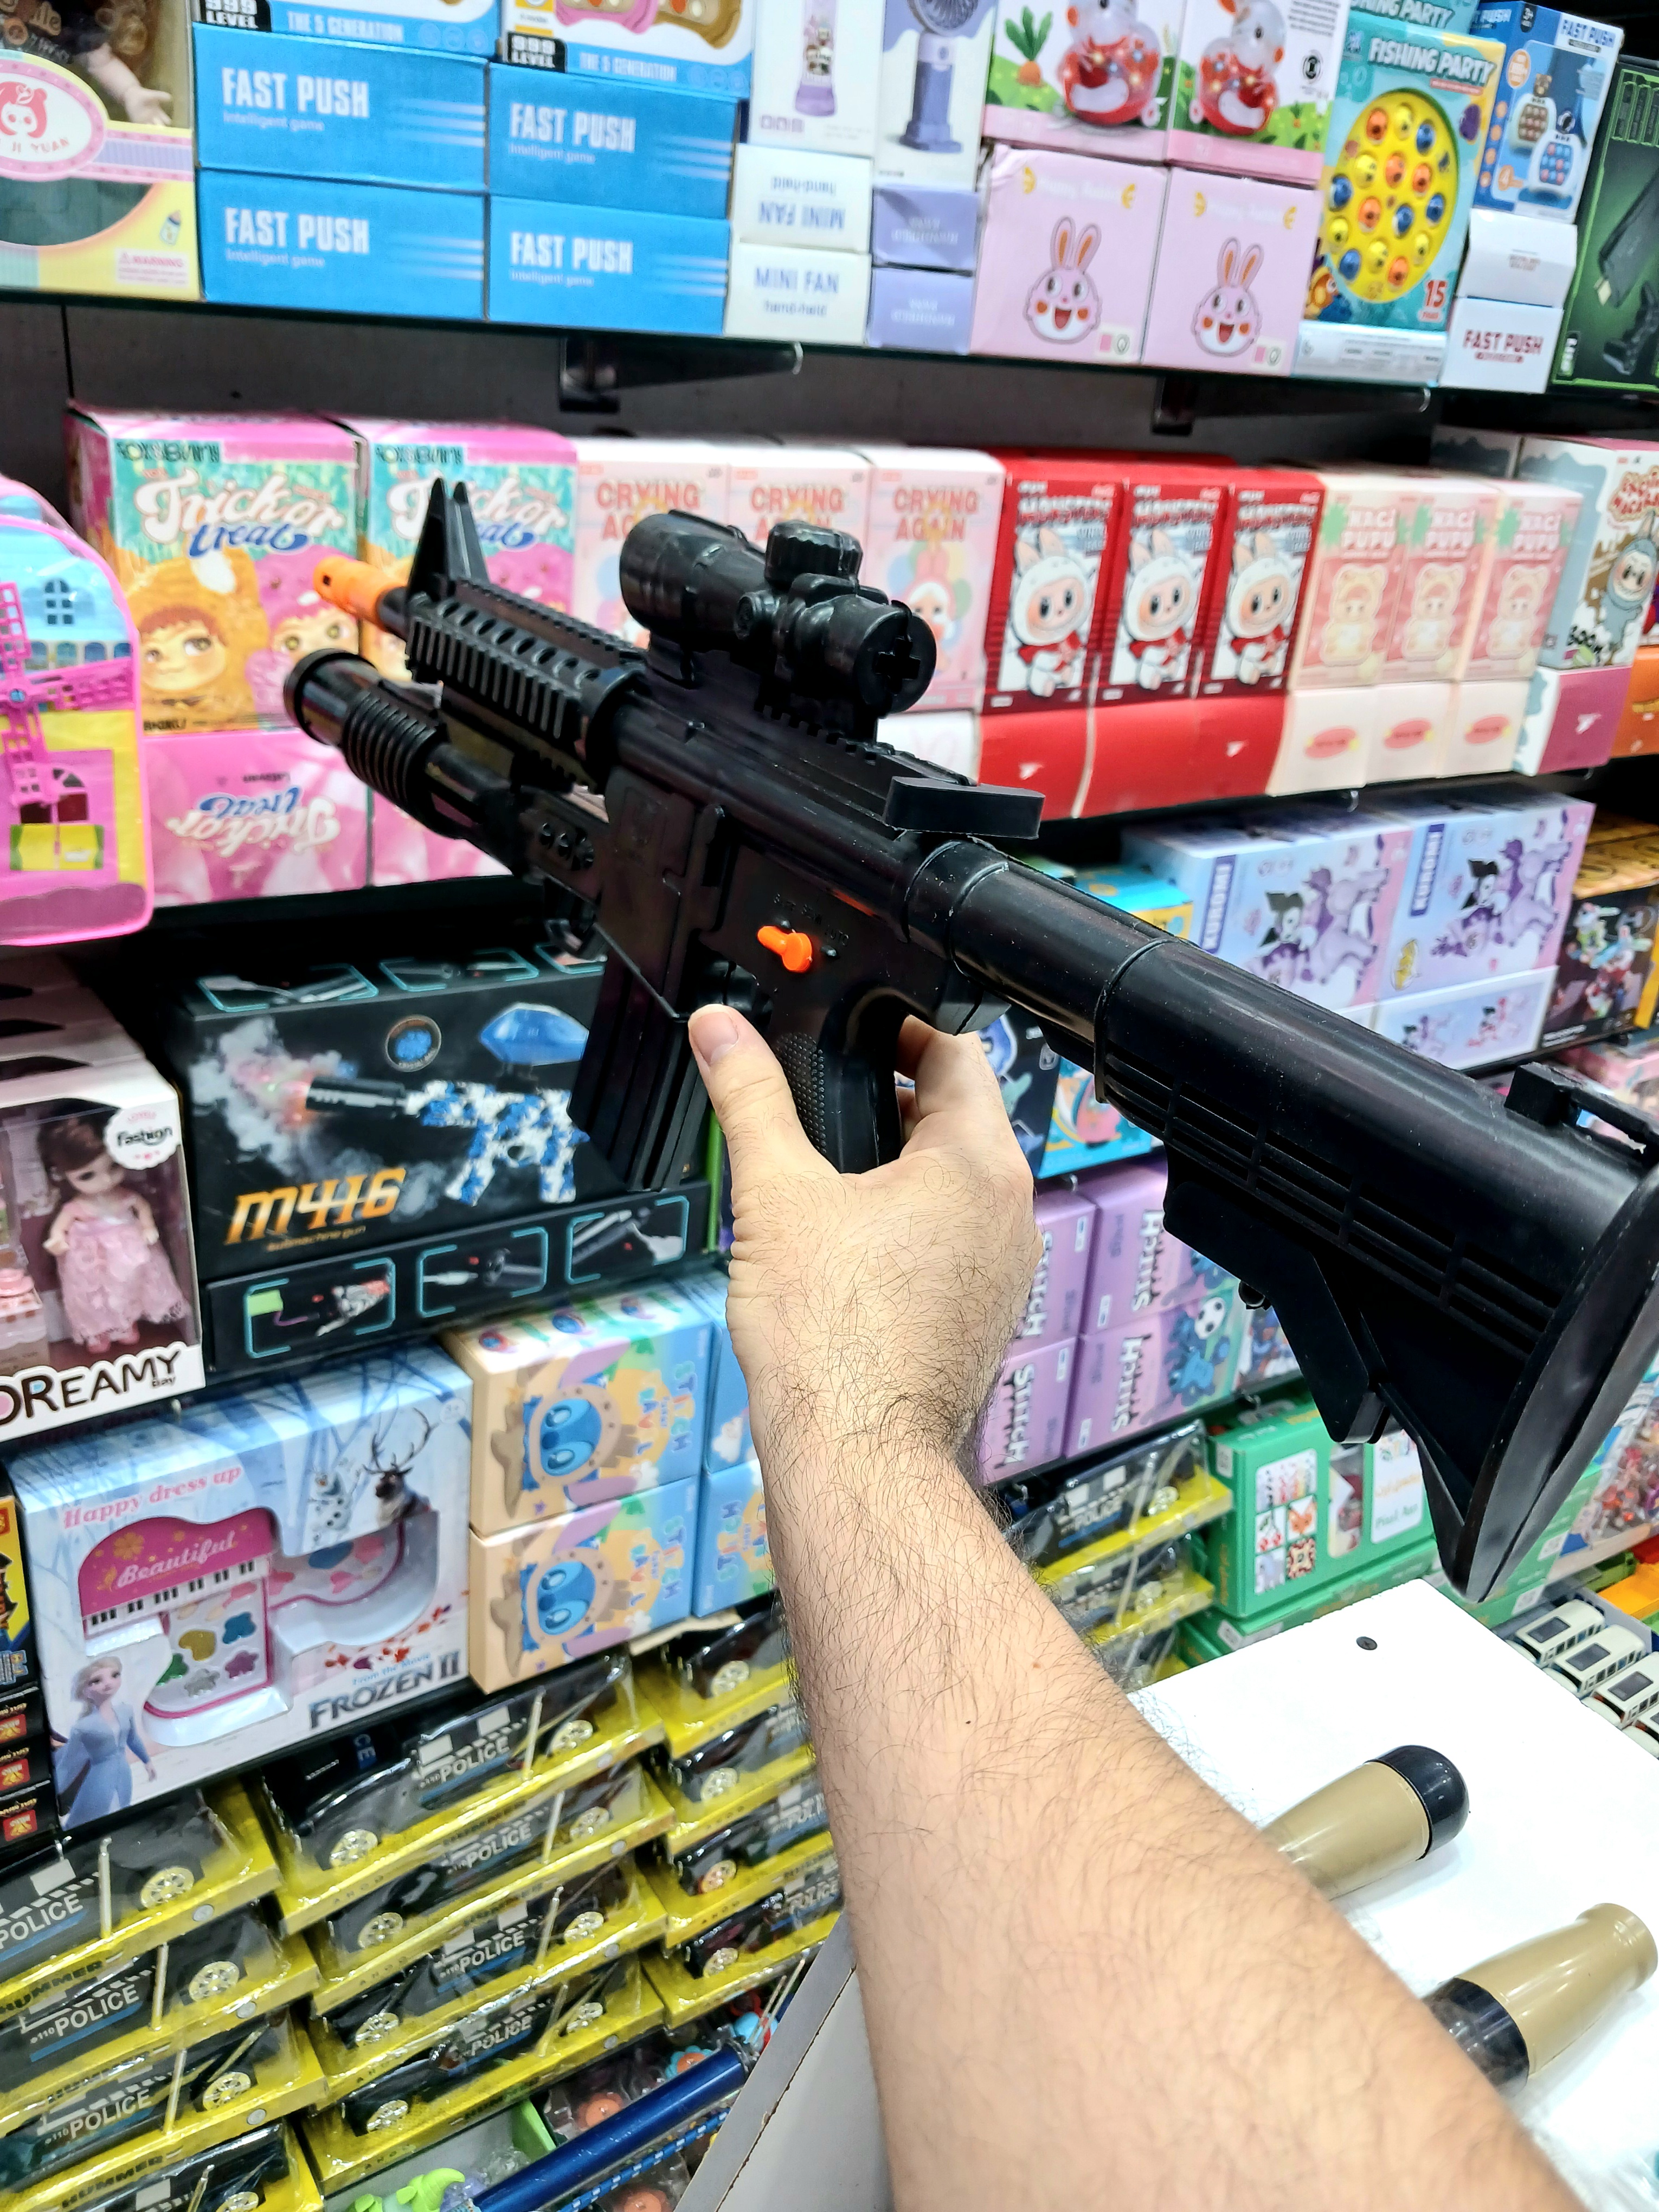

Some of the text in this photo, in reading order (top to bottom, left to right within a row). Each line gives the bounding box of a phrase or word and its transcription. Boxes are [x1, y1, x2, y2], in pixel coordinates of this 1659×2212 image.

[206, 11, 259, 29] LEVEL
[1399, 0, 1455, 29] PARTY
[1561, 19, 1587, 40] FAST
[1589, 25, 1616, 48] PUSH
[512, 52, 556, 68] LEVEL
[1368, 37, 1497, 86] FISHING PARTY
[222, 68, 370, 118] FAST PUSH
[223, 112, 325, 131] Intelligent game
[510, 103, 635, 153] FAST PUSH
[31, 138, 69, 153] YUAN
[226, 208, 370, 254] FAST PUSH
[760, 201, 845, 230] MINI FAN
[226, 249, 325, 268] Intelligent game
[510, 232, 633, 274] FAST PUSH
[755, 266, 839, 294] MINI FAN
[1426, 279, 1448, 308] 15
[1463, 329, 1501, 350] FAST
[1504, 335, 1544, 356] PUSH
[597, 482, 700, 511] CRYING
[750, 487, 844, 513] CRYING
[894, 488, 979, 515] CRYING
[896, 517, 966, 542] AGAIN
[1413, 832, 1443, 911] KUROMI
[1202, 863, 1232, 950] KUROMI
[1133, 1210, 1165, 1312] STITCH
[671, 1360, 698, 1454] STITCH
[1110, 1336, 1144, 1433] STITCH
[1003, 1364, 1036, 1465] STITCH
[64, 1467, 242, 1529] Happy dress up
[117, 1530, 235, 1589] Beautiful
[661, 1515, 687, 1600] STITCH
[717, 1500, 744, 1582] STITCH
[309, 1650, 460, 1729] FROZEN II
[352, 1653, 432, 1686] From the Movie
[439, 1735, 511, 1783] POLICE
[467, 1822, 532, 1869] POLICE
[0, 1893, 83, 1950] POLICE
[459, 1930, 525, 1974] POLICE
[54, 1984, 139, 2036] POLICE
[470, 2015, 533, 2056] POLICE
[69, 2088, 152, 2139] POLICE
